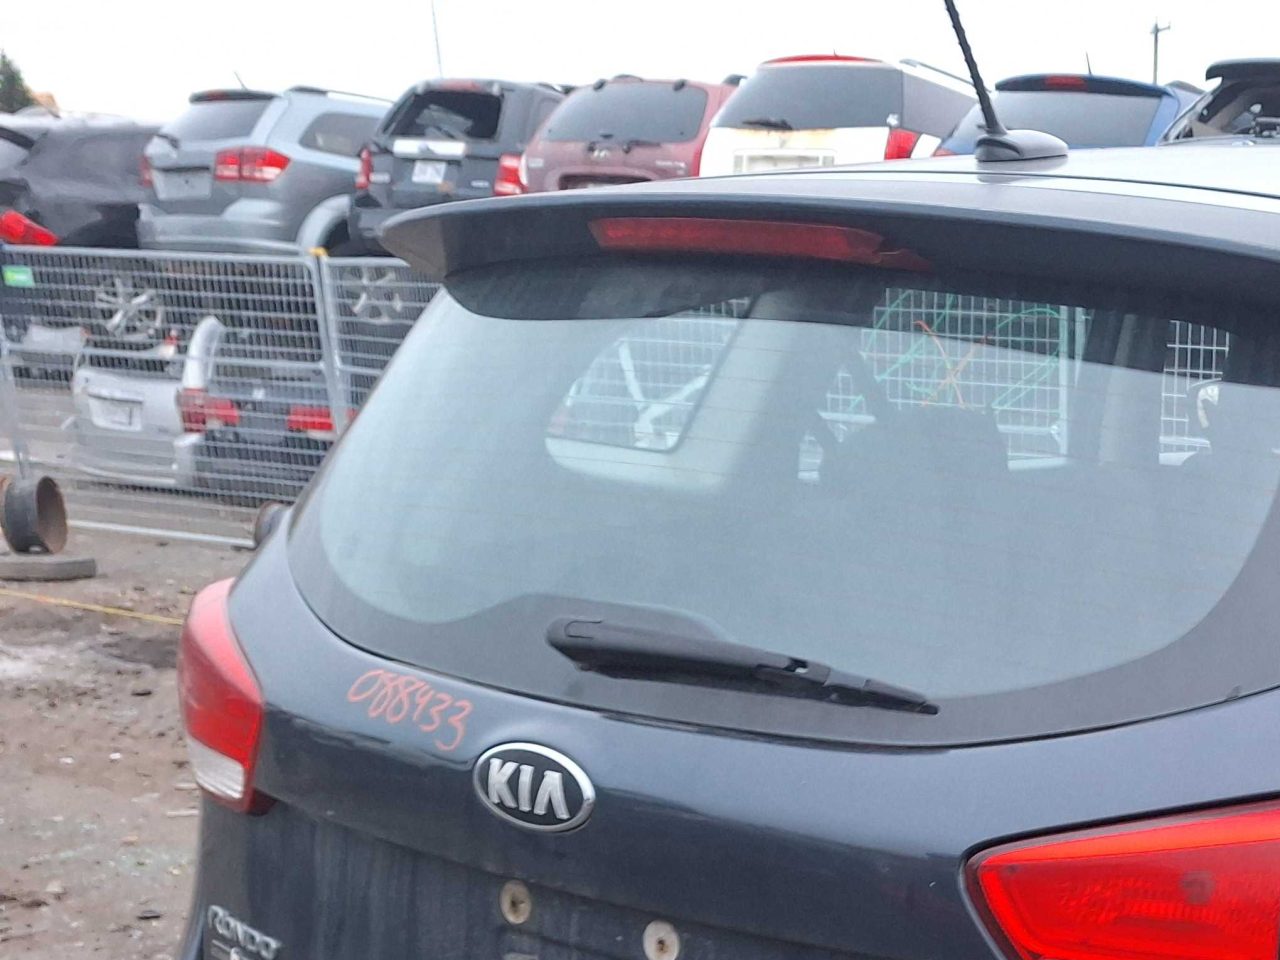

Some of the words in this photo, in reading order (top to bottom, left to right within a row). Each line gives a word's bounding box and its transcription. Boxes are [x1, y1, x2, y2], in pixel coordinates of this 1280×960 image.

[347, 668, 473, 751] 088433
[488, 757, 571, 820] KIA
[208, 905, 281, 960] RONDO
